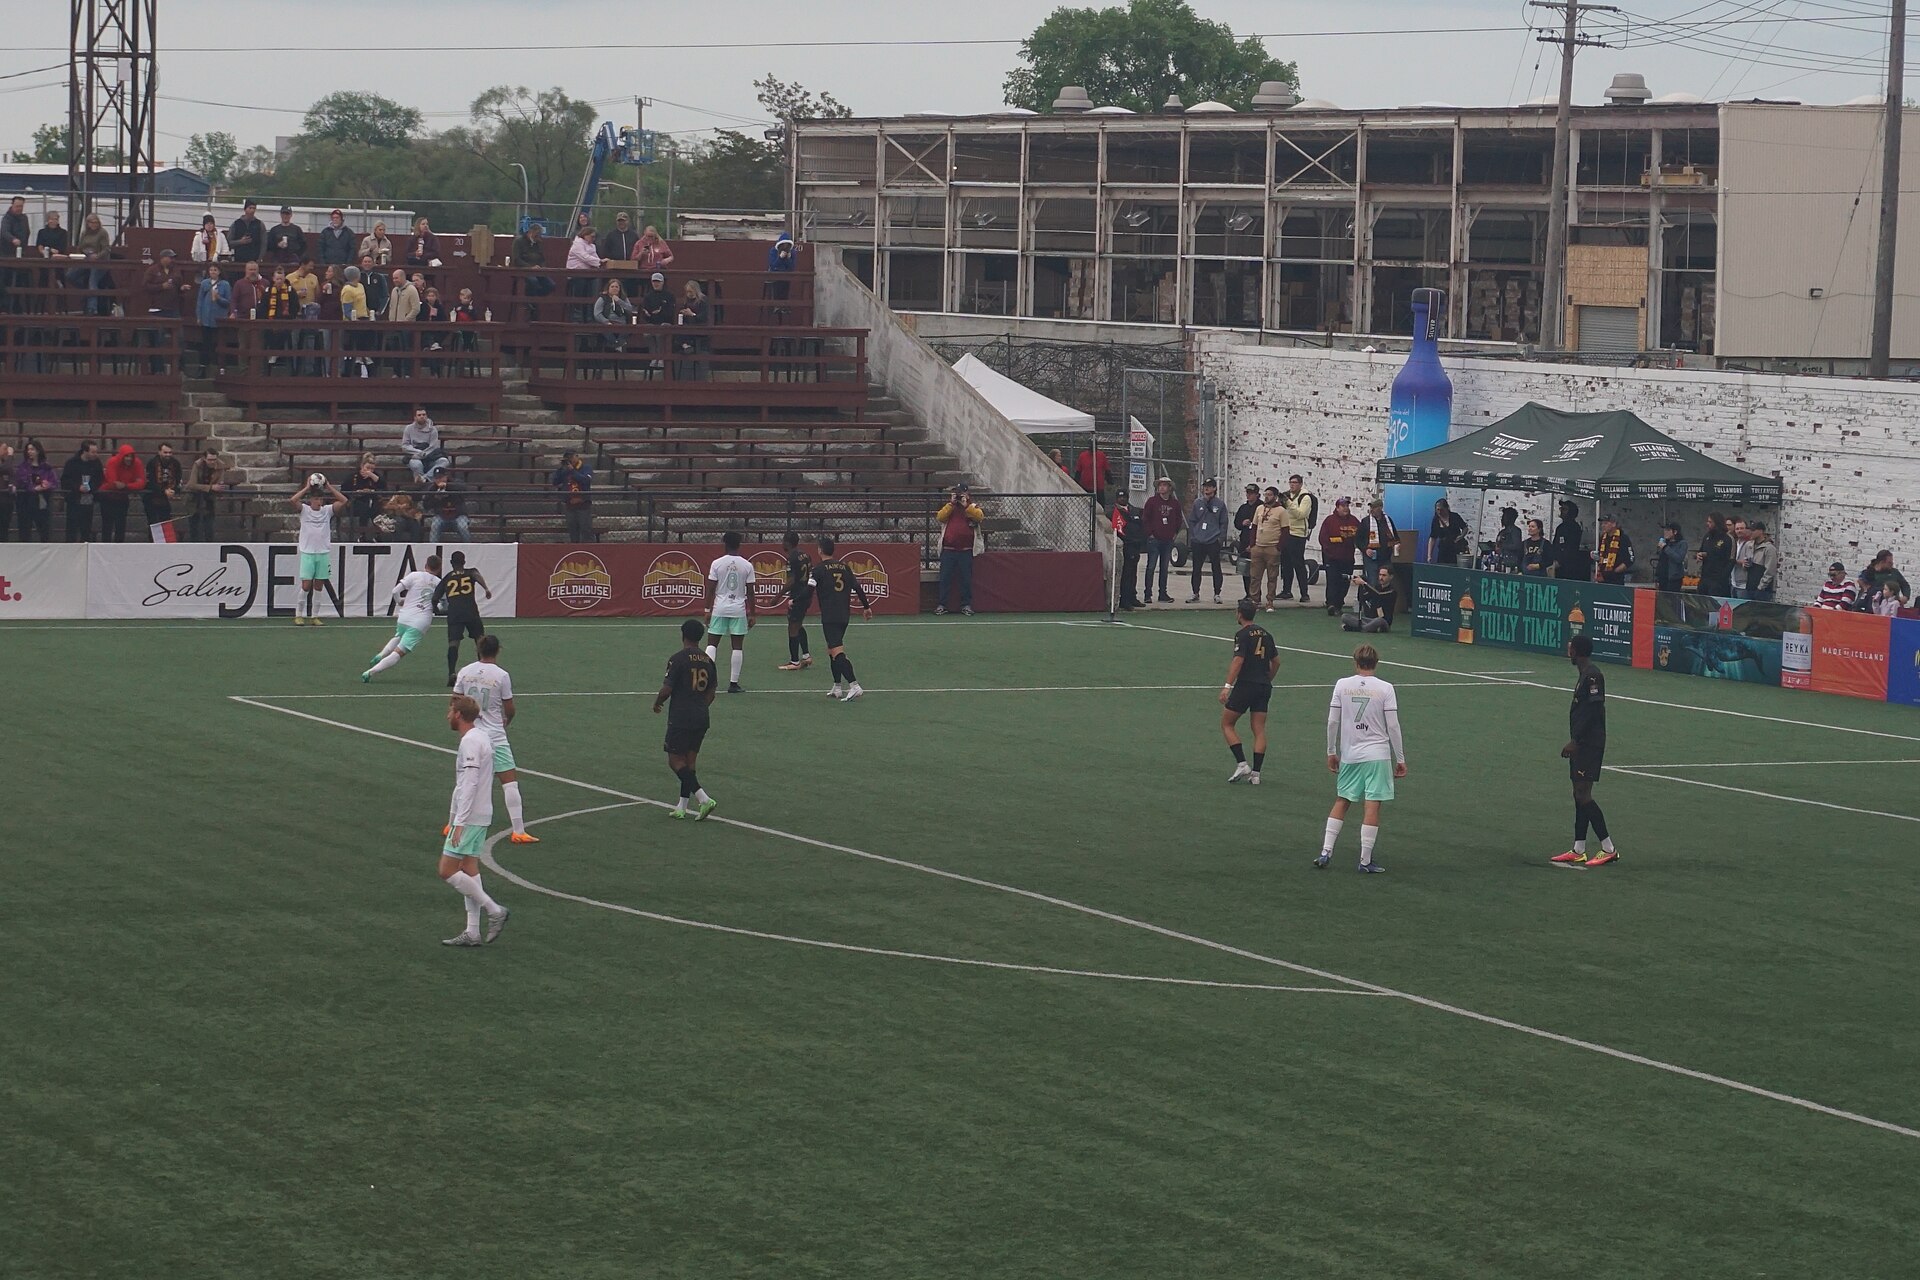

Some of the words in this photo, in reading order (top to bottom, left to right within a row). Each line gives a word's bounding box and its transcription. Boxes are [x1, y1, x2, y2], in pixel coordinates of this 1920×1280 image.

[1490, 436, 1534, 451] TULLAMORE
[1631, 445, 1678, 454] TULLAMORE
[142, 564, 245, 606] Salim
[447, 576, 473, 597] 25
[727, 572, 738, 591] 8
[833, 573, 844, 592] 3
[551, 585, 609, 597] FIELDHOUSE
[644, 585, 703, 597] FIELDHOUSE
[1418, 587, 1452, 601] TULLAMORE
[1481, 578, 1520, 609] GAME
[1524, 582, 1562, 618] TIME,
[1427, 602, 1441, 614] DEW
[1593, 608, 1631, 623] TULLAMORE
[1480, 611, 1518, 642] TULLY
[1523, 616, 1562, 649] TIME!
[1604, 624, 1619, 636] DEW
[1254, 637, 1265, 659] 4
[1785, 642, 1809, 654] REYKA
[1822, 646, 1842, 656] MADE
[1851, 652, 1884, 661] ICELAND
[690, 668, 709, 692] 18
[1352, 697, 1370, 723] 7
